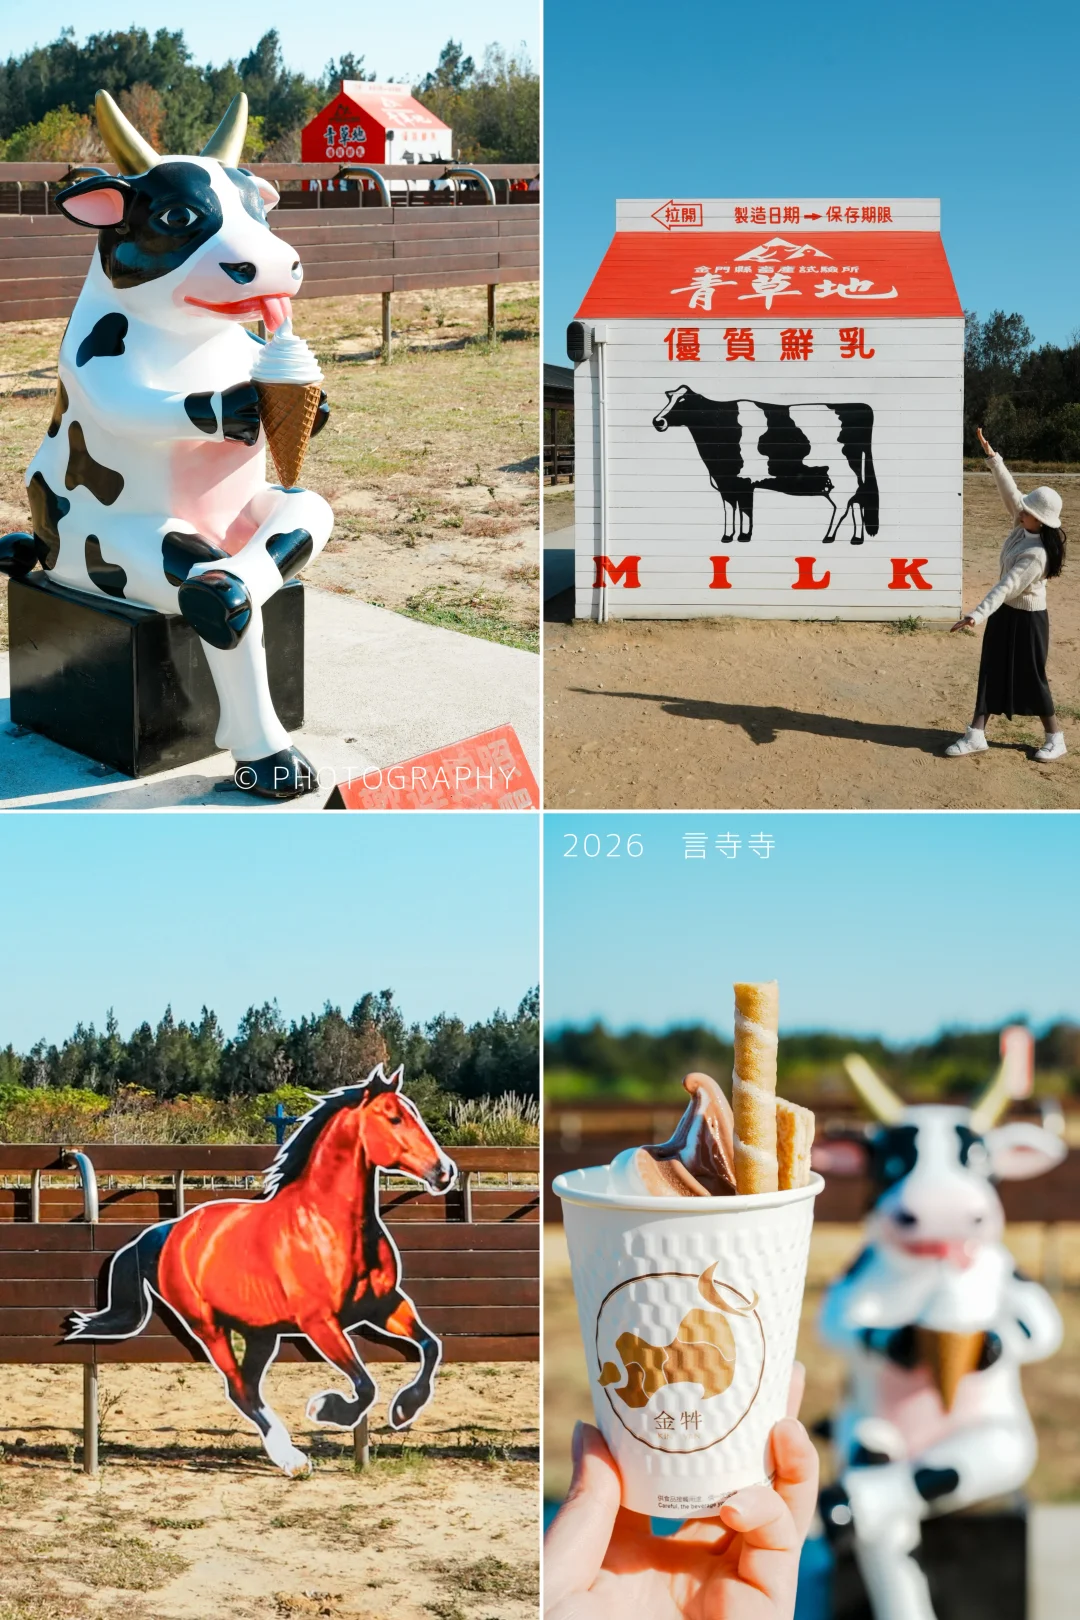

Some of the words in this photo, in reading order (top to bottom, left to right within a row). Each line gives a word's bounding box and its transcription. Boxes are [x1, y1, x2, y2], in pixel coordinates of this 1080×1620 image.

[323, 124, 367, 147] 青草地
[664, 207, 697, 223] 拉開
[734, 206, 800, 225] 製造日期
[825, 205, 893, 224] 保存期限
[693, 265, 860, 274] 金門縣畜產試驗所
[670, 274, 899, 311] 青草地
[663, 326, 876, 362] 優質鮮乳
[592, 556, 933, 590] MILK
[653, 1410, 703, 1431] 金牪
[657, 1502, 679, 1510] Careful,
[691, 1502, 717, 1510] beverage
